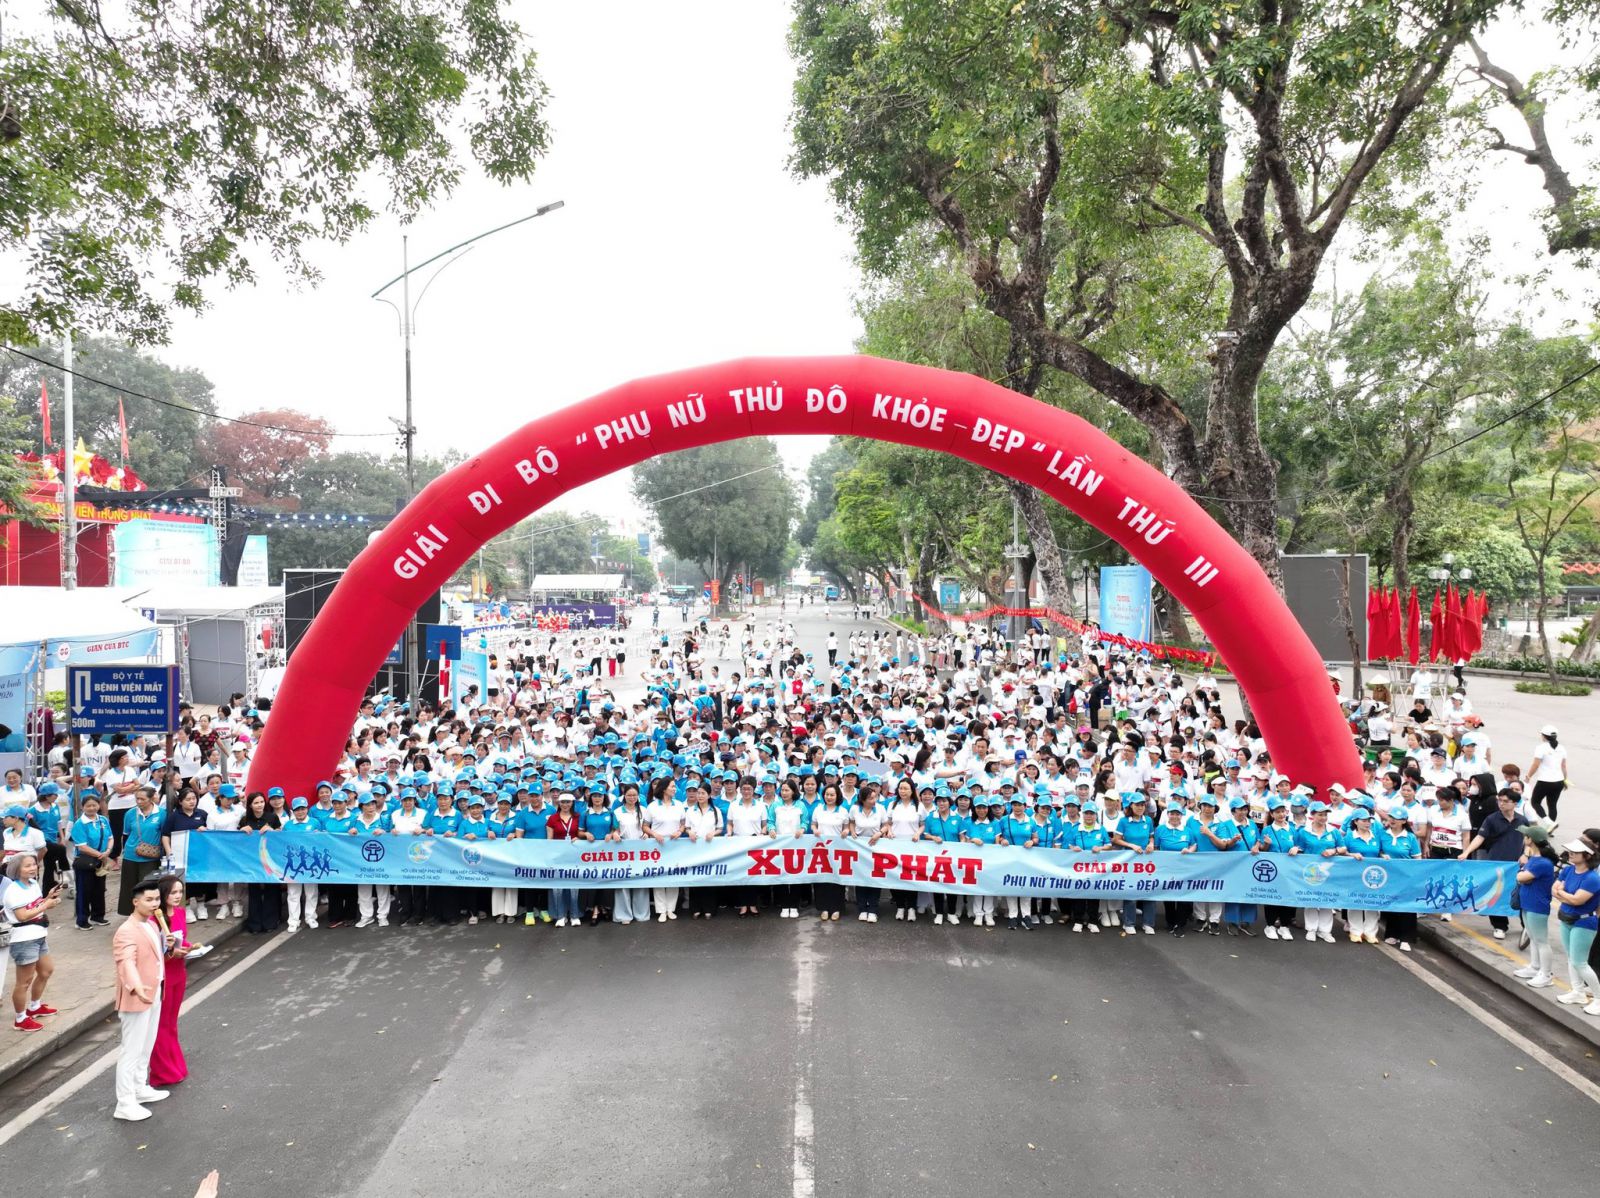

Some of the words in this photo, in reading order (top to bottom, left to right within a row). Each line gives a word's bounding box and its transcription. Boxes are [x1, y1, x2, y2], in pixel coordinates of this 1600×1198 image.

[393, 524, 449, 579] GIẢI
[468, 483, 503, 516] ĐI
[515, 445, 559, 485] BỘ
[667, 392, 707, 428] NỮ
[729, 380, 783, 414] THỦ
[806, 384, 847, 413] ĐÔ
[872, 393, 948, 432] KHỎE
[1046, 450, 1104, 496] LẦN
[1117, 496, 1176, 545] THỨ
[1183, 555, 1220, 588] III
[112, 672, 125, 681] BỘ
[135, 670, 145, 680] TẾ
[94, 683, 119, 693] BỆNH
[121, 683, 141, 693] VIỆN
[144, 683, 163, 692] MẮT
[99, 695, 130, 703] TRUNG
[132, 694, 157, 703] ƯƠNG
[72, 718, 96, 728] 500m
[581, 850, 613, 862] GIẢI
[617, 851, 635, 862] ĐI
[639, 848, 661, 864] BỘ
[747, 839, 858, 876] XUẤT
[871, 850, 983, 885] PHÁT
[715, 864, 728, 876] III
[1073, 861, 1107, 873] GIẢI
[1111, 862, 1129, 873] ĐI
[1133, 860, 1156, 876] BỘ
[1003, 873, 1027, 890] PHỤ
[1074, 877, 1091, 890] ĐÔ
[1136, 879, 1159, 892] ĐẸP
[1210, 879, 1225, 891] III
